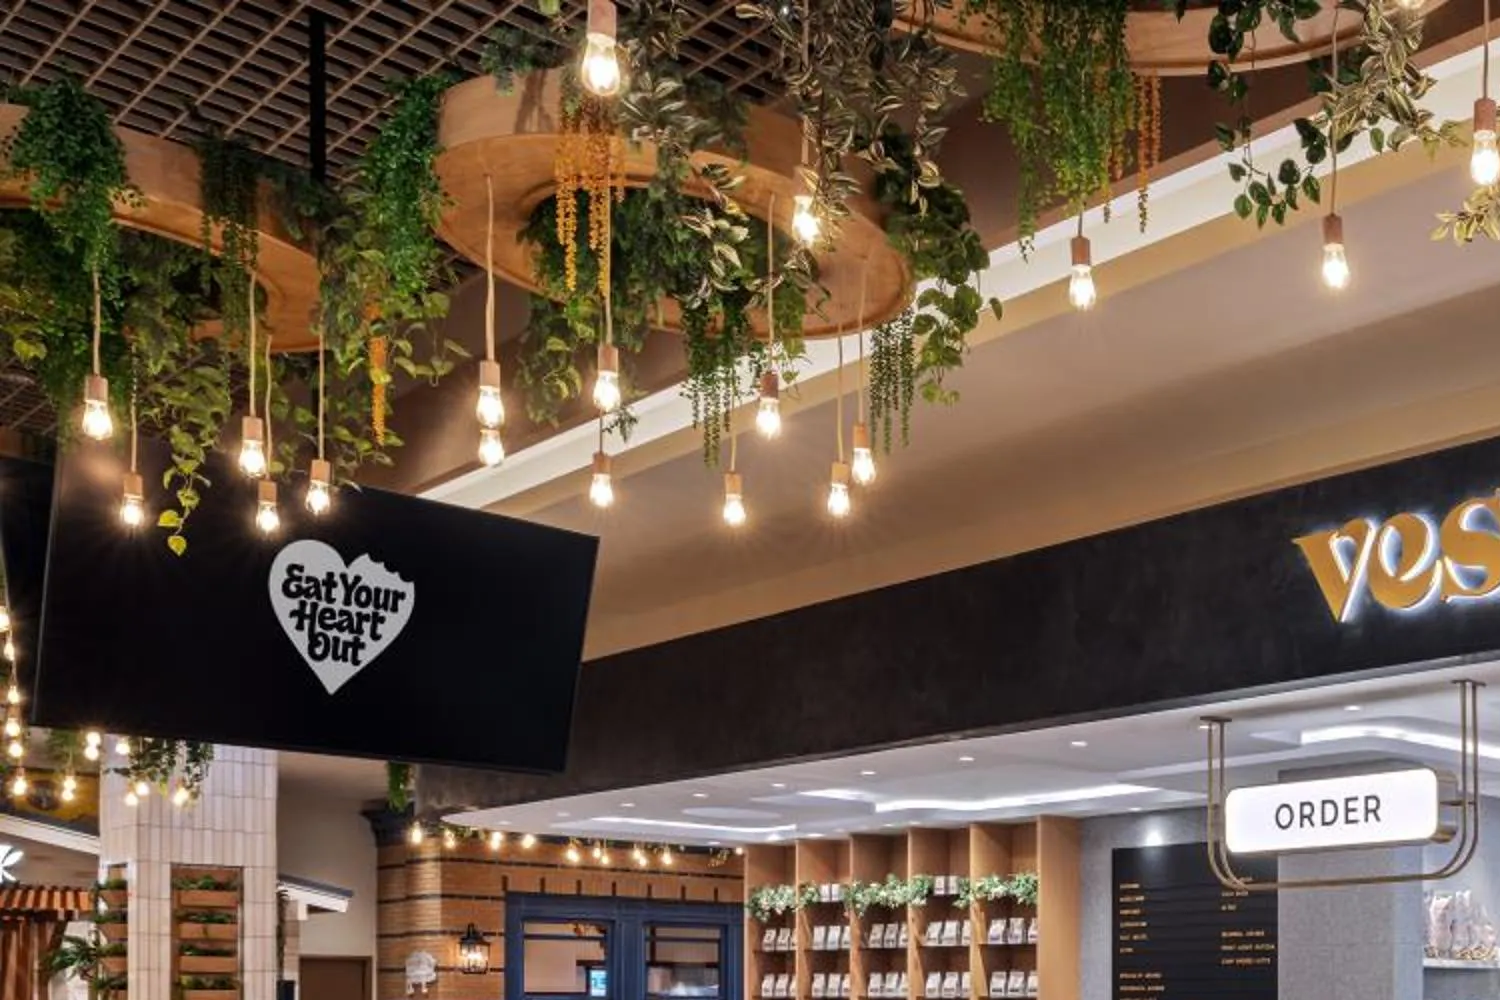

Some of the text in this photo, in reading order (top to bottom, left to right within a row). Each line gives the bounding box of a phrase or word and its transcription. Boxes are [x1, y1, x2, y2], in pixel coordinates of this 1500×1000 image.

[281, 563, 407, 614] Eat Your
[289, 600, 386, 642] Heart
[307, 631, 366, 667] Out
[1275, 794, 1382, 831] ORDER
